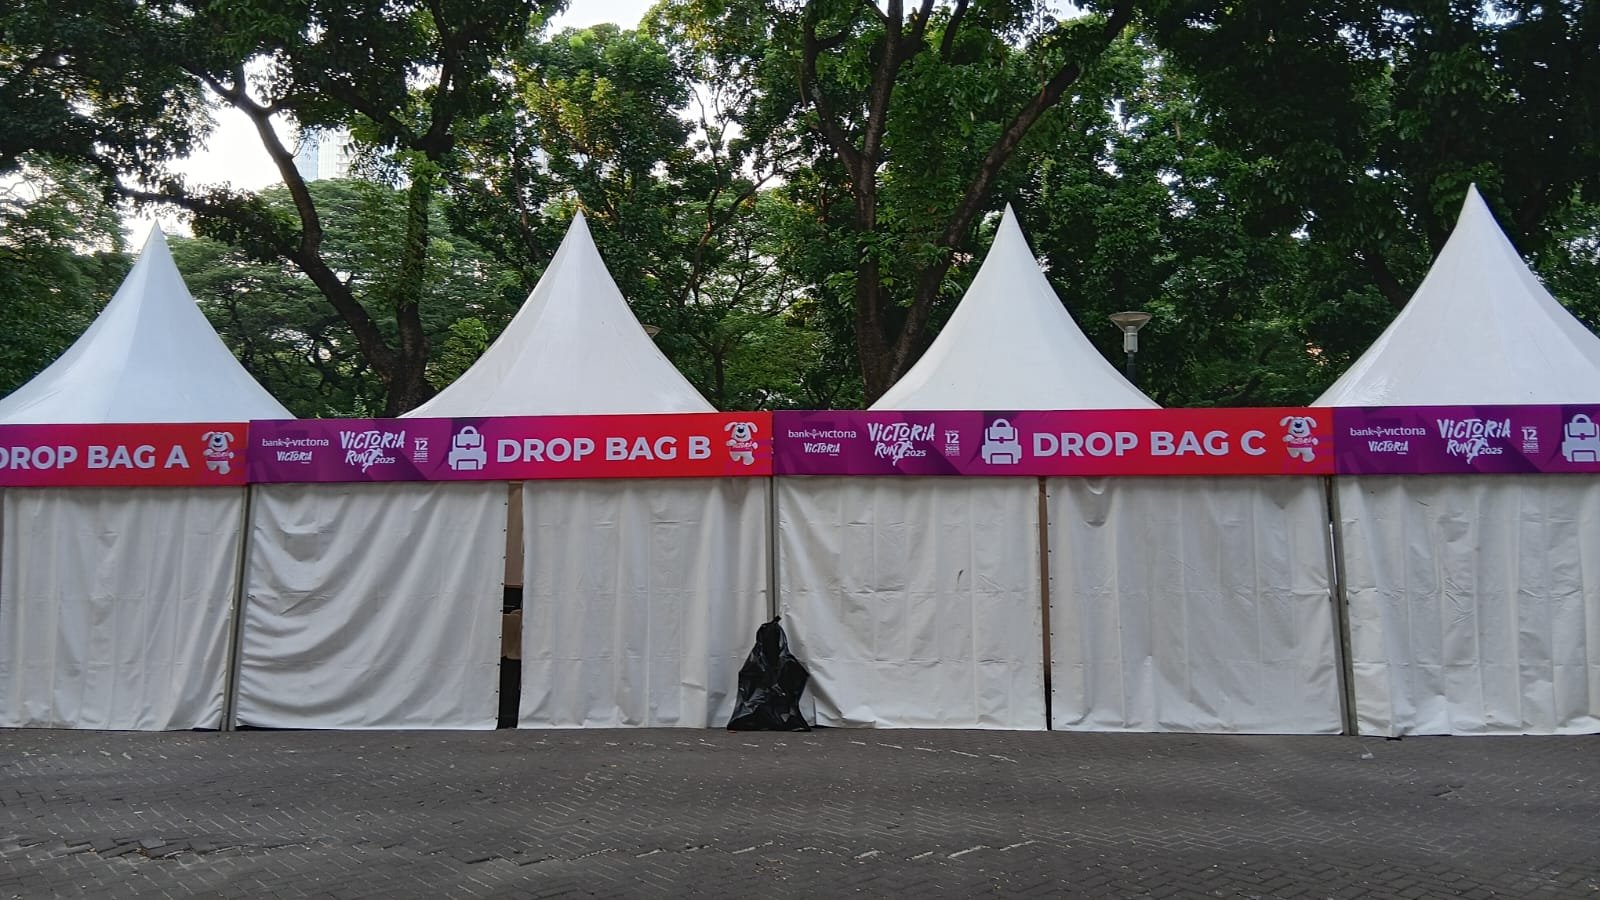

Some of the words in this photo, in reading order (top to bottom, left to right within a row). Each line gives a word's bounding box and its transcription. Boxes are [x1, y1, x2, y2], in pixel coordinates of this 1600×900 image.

[788, 429, 810, 438] bank
[1350, 427, 1374, 436] bank
[1521, 429, 1538, 441] 12
[262, 438, 284, 447] bank
[945, 433, 960, 444] 12
[1032, 431, 1138, 457] DROP
[1150, 430, 1229, 456] BAG
[1240, 430, 1266, 456] C
[414, 440, 428, 451] 12
[497, 437, 595, 463] DROP
[605, 436, 677, 461] BAG
[688, 436, 711, 460] B
[1479, 447, 1503, 455] 2025
[87, 445, 156, 469] BAG
[164, 445, 190, 469] A
